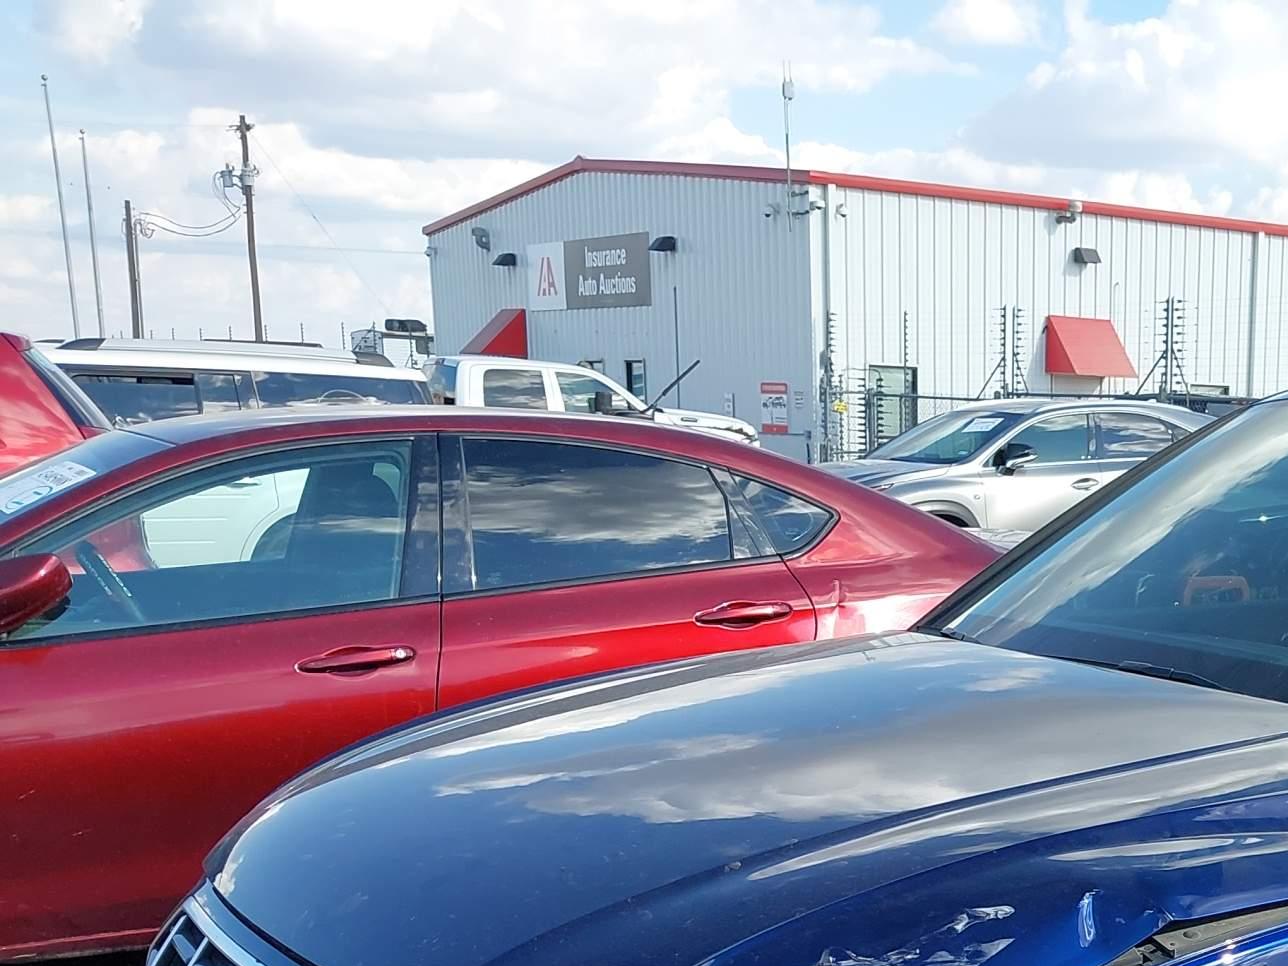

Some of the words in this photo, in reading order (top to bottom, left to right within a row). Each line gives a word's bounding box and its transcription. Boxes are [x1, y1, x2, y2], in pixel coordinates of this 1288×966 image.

[584, 246, 627, 268] Insurance
[578, 274, 598, 297] Auto
[599, 271, 637, 295] Auctions
